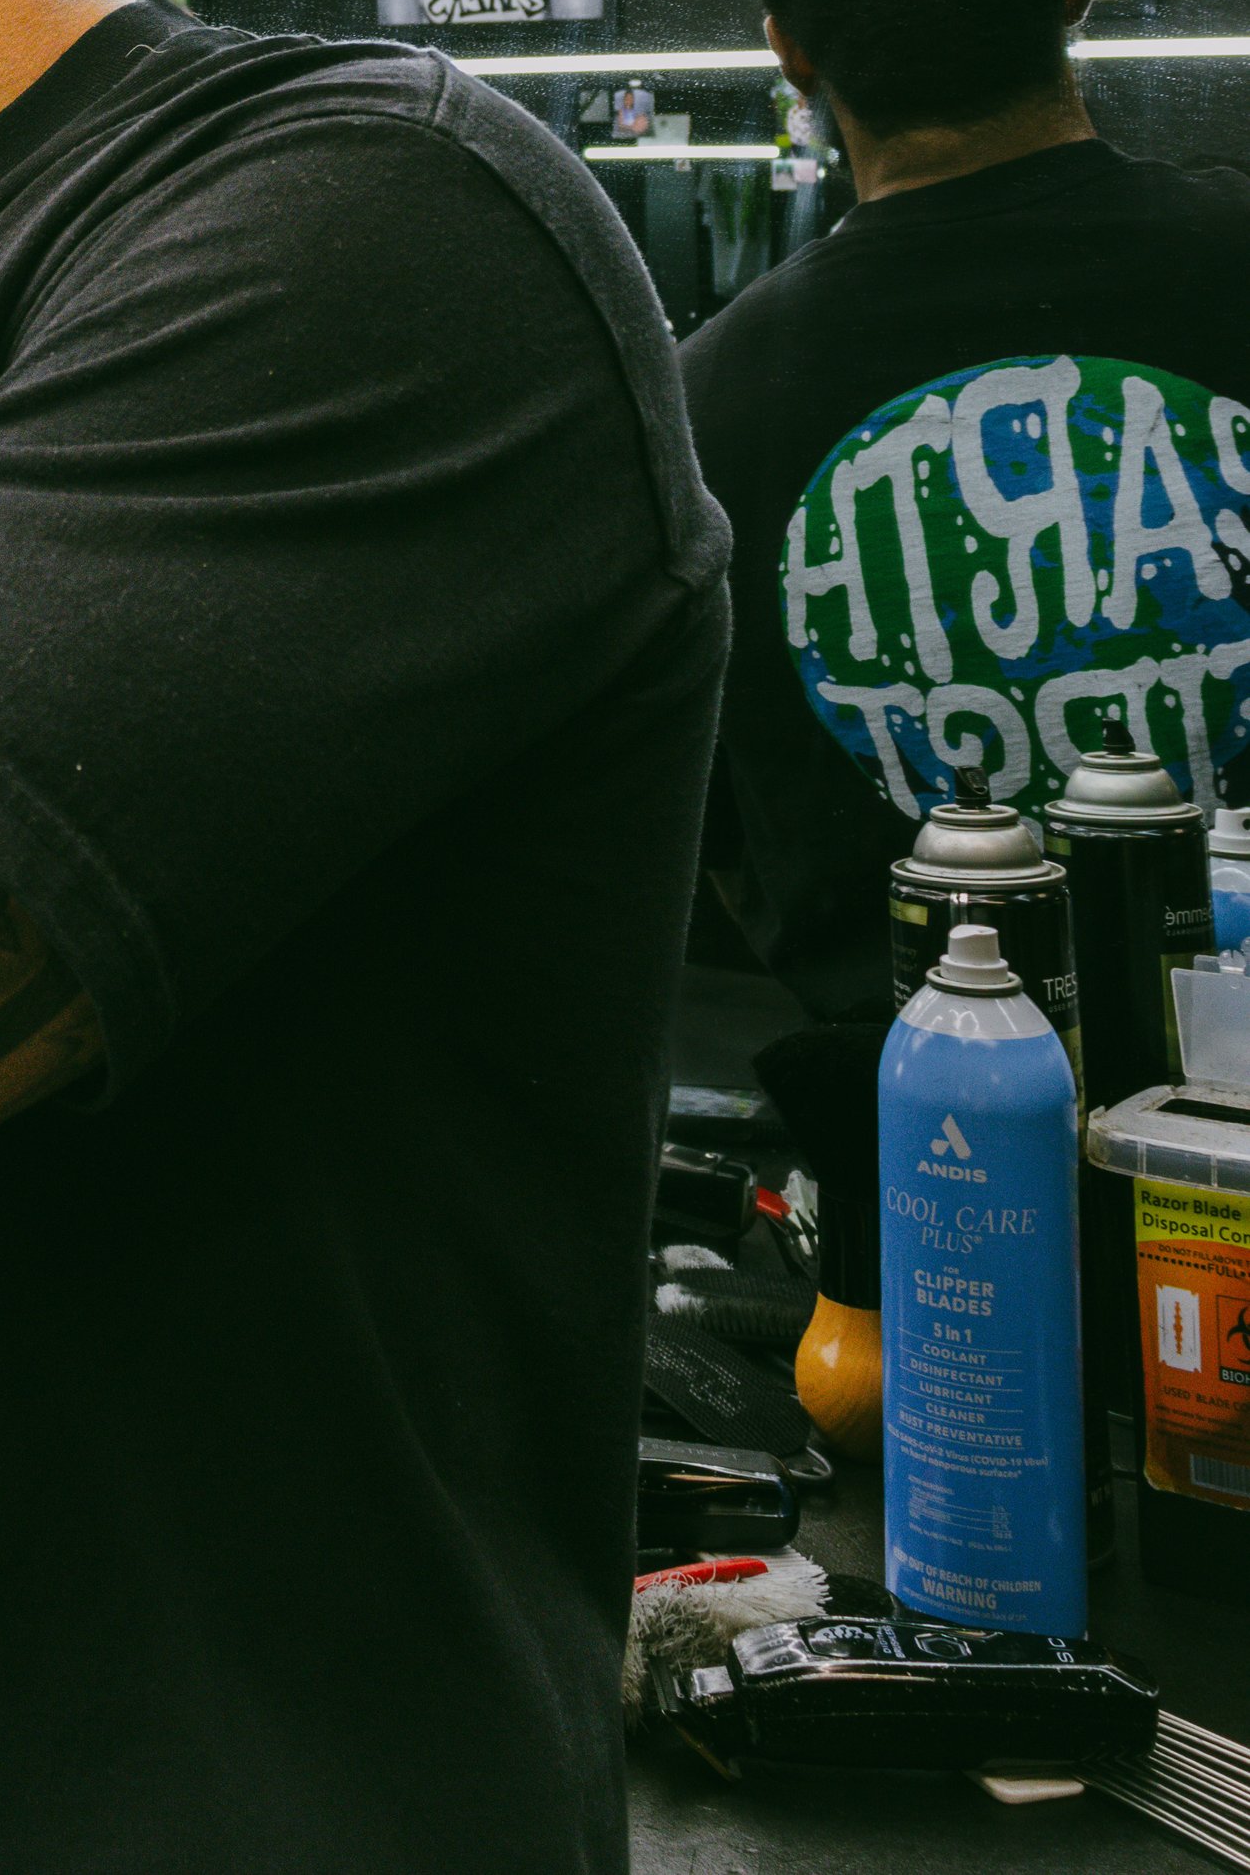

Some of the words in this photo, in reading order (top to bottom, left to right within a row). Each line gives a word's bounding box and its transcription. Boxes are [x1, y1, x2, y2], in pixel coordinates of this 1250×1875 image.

[917, 1160, 988, 1183] ANDIS
[886, 1186, 944, 1226] COOL
[955, 1206, 1038, 1235] CARE
[1141, 1191, 1188, 1211] Razor
[1194, 1200, 1242, 1221] Blade
[1142, 1212, 1214, 1239] Disposal
[914, 1269, 995, 1298] CLIPPER
[916, 1288, 992, 1317] BLADES
[933, 1322, 942, 1339] 5
[965, 1328, 972, 1344] 1
[922, 1343, 988, 1365] COOLANT
[909, 1358, 1003, 1386] DISINFECTANT
[919, 1381, 993, 1405] LUBRICANT
[926, 1403, 985, 1424] CLEANER
[927, 1421, 1023, 1447] PREVENTATIVE
[921, 1577, 997, 1609] WARNING
[939, 1569, 972, 1587] REACH
[991, 1581, 1042, 1592] CHILDREN
